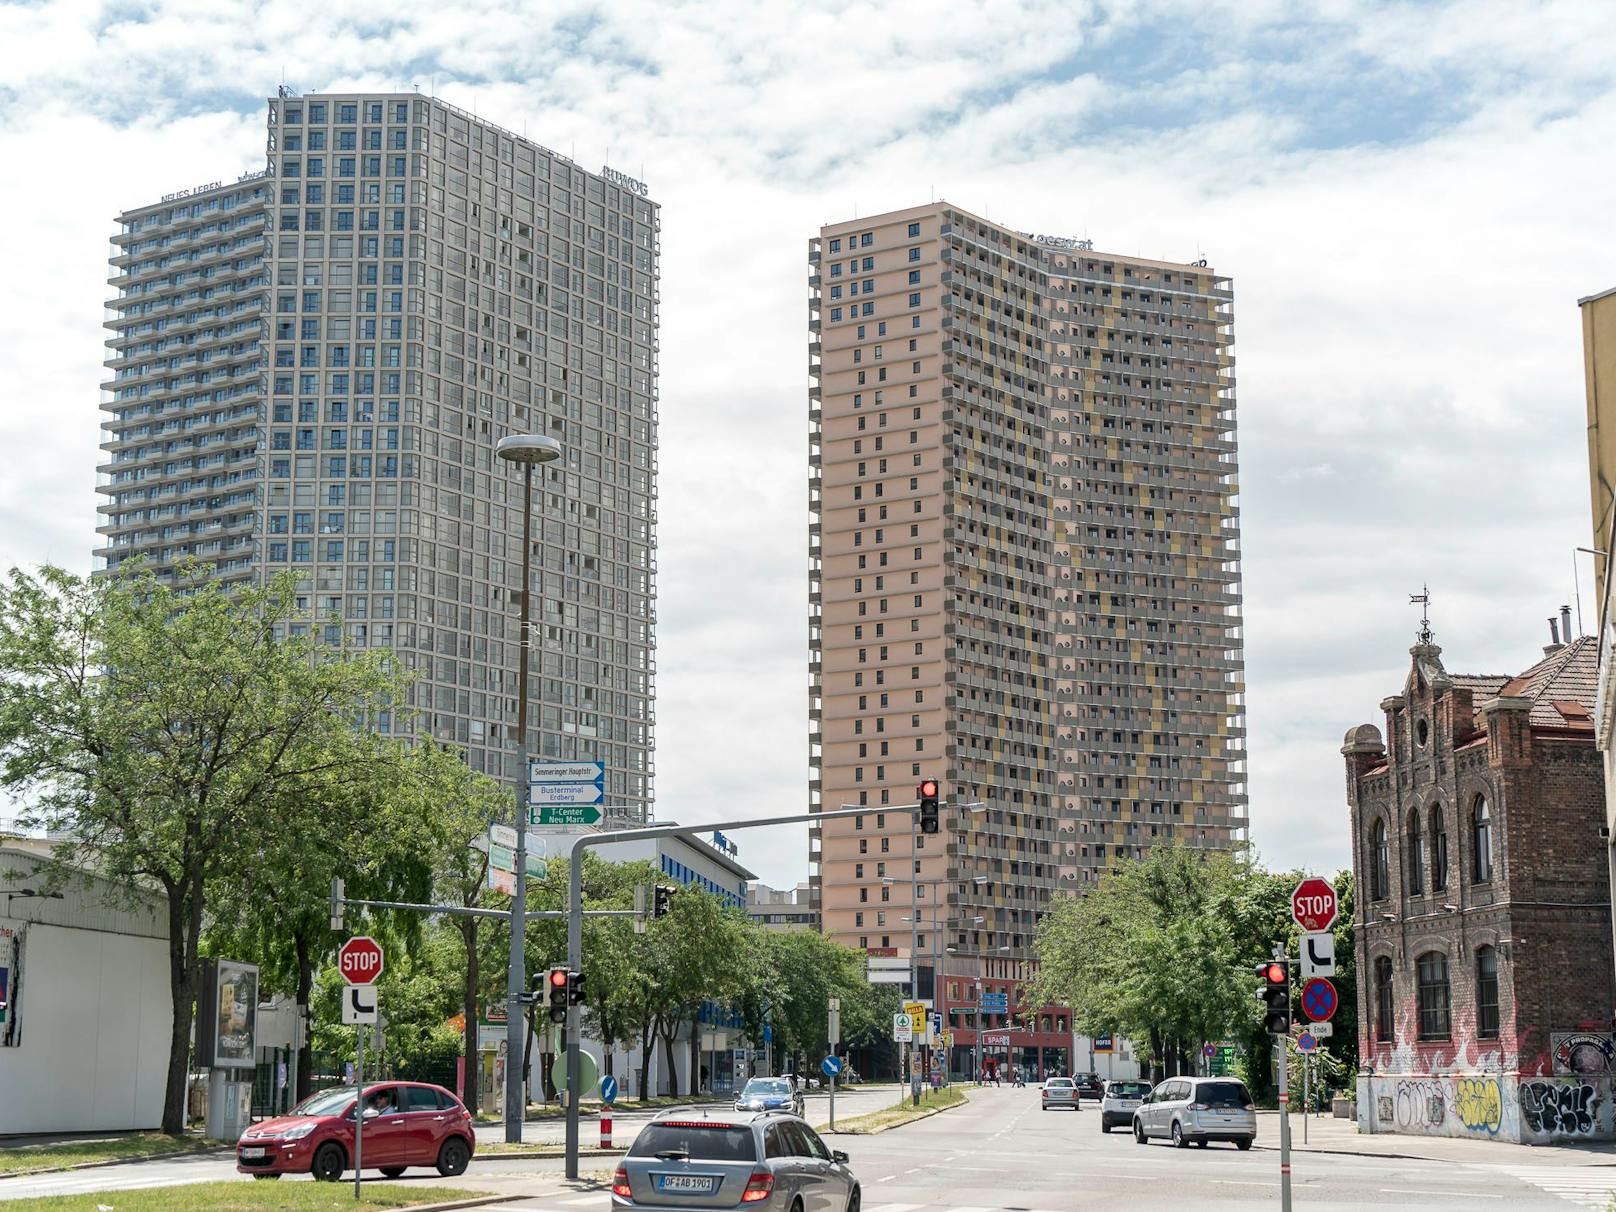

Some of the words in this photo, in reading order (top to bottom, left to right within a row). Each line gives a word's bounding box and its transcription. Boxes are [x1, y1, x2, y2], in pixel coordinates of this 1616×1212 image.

[193, 181, 222, 196] LEBEN
[535, 767, 567, 777] Simmeringer
[541, 786, 584, 794] Busterminal
[1296, 895, 1333, 917] STOP
[343, 951, 378, 971] STOP
[1313, 1024, 1328, 1034] Ende
[987, 1036, 1003, 1044] SPAR
[665, 1176, 674, 1187] OF
[680, 1177, 691, 1188] AB
[692, 1177, 711, 1189] 1901
